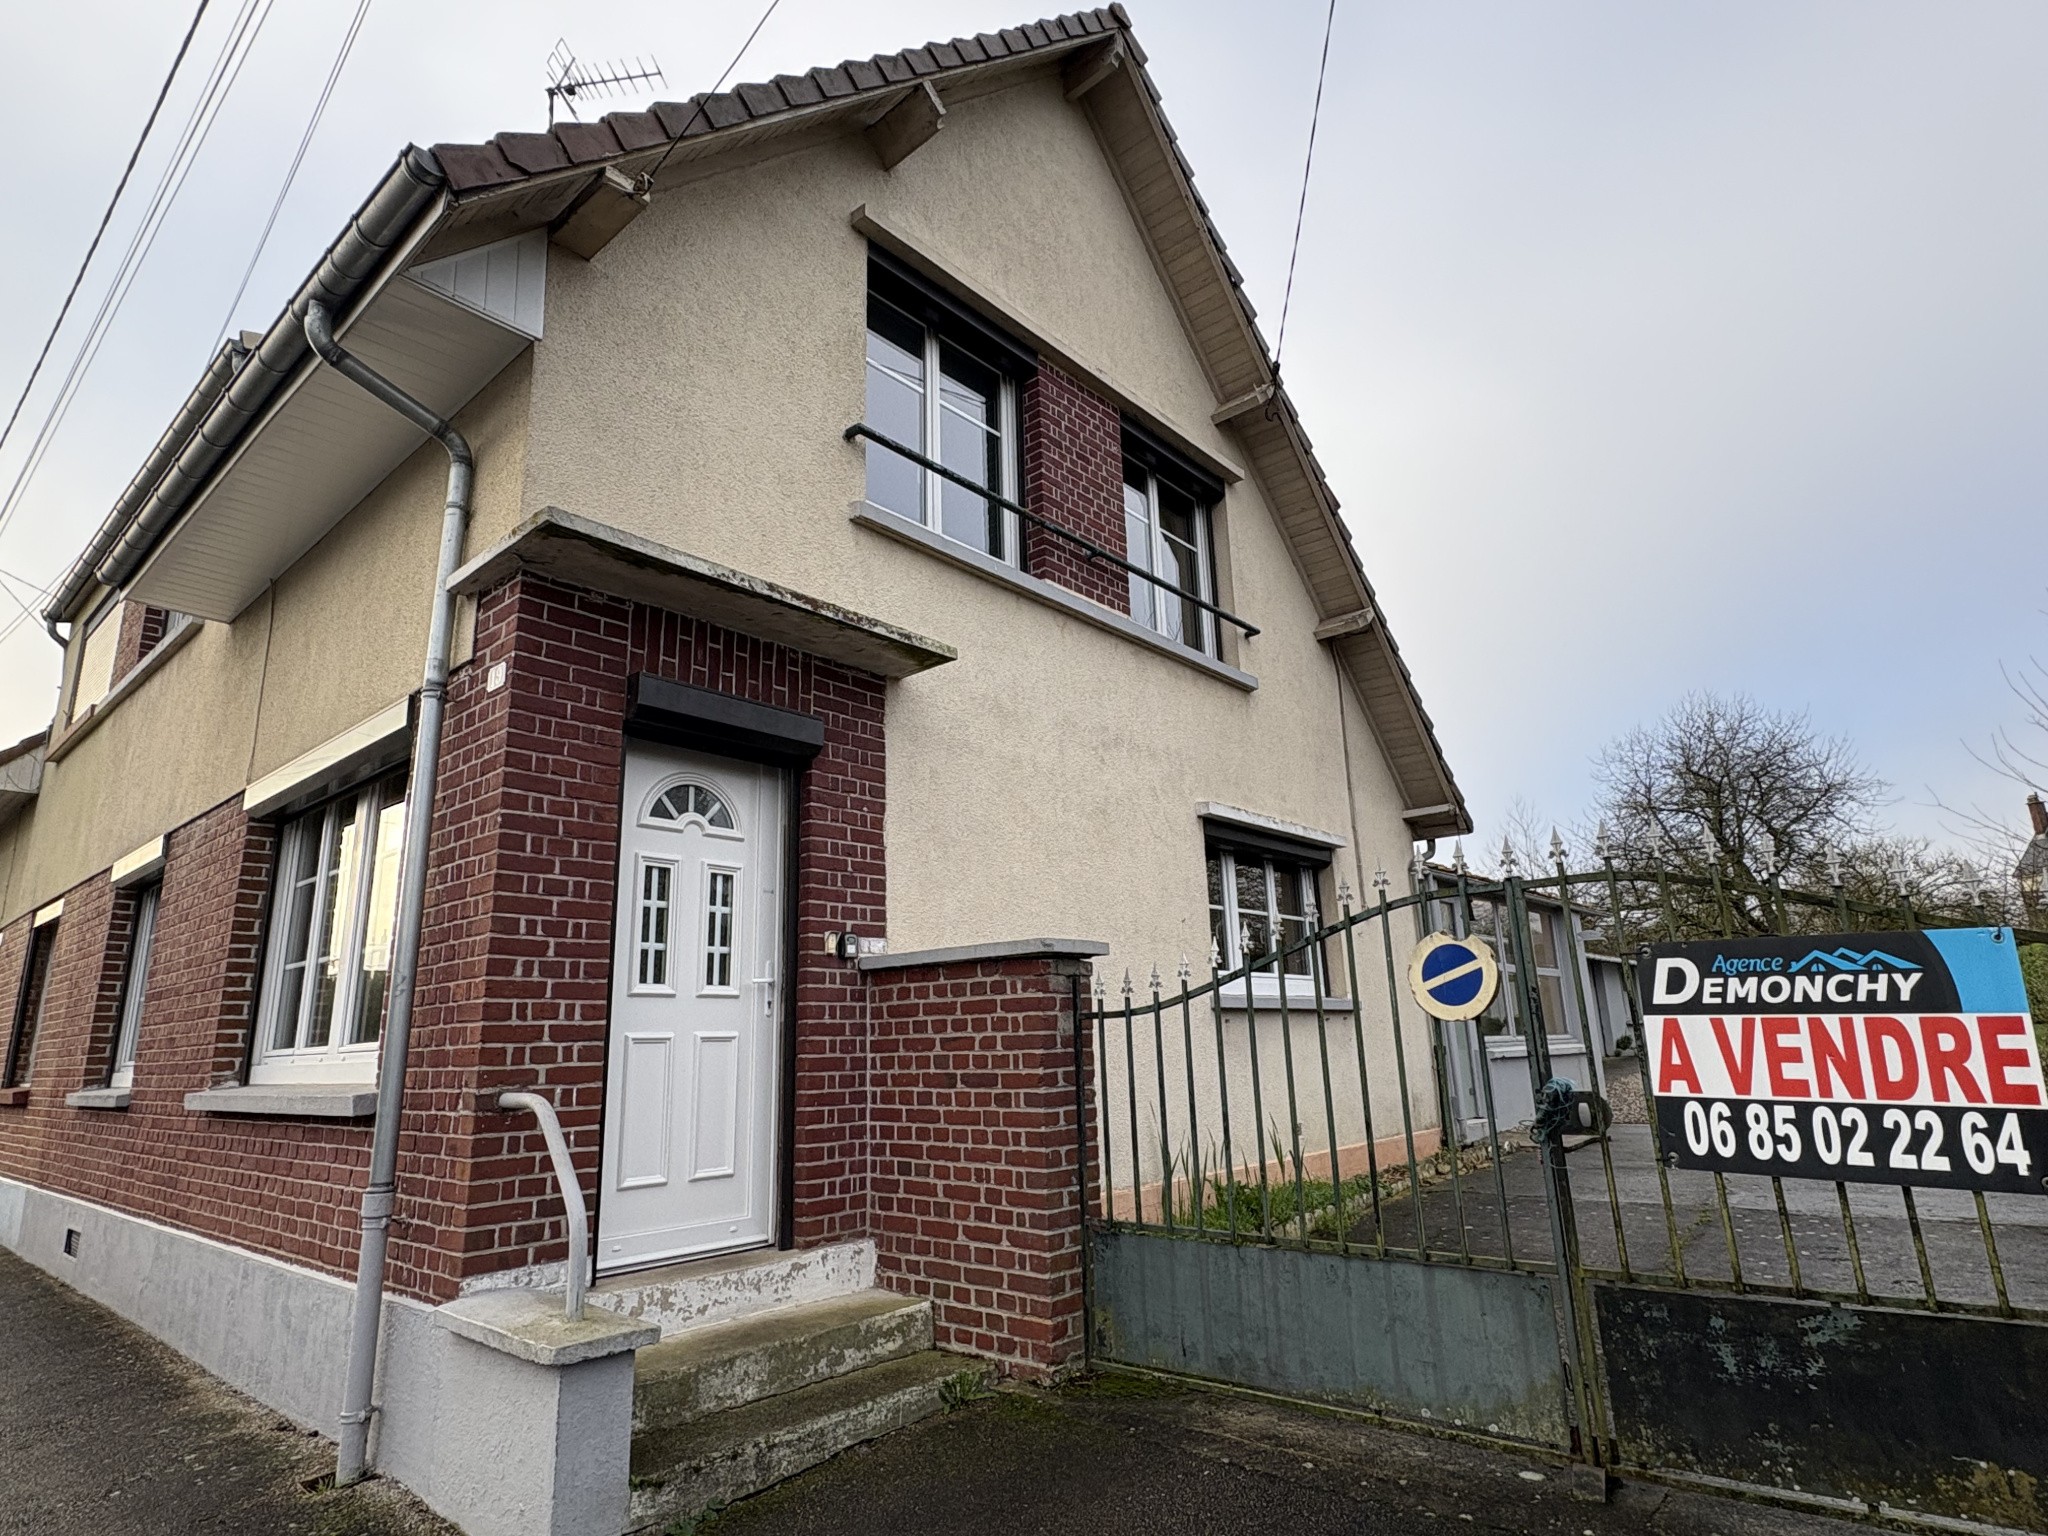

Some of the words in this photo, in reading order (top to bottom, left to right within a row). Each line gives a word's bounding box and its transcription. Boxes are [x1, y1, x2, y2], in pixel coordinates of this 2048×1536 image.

[1652, 957, 1923, 1005] DEMONCHY
[1711, 954, 1783, 976] Agence
[1658, 1018, 1703, 1094] A
[1709, 1016, 2041, 1105] VENDRE
[1684, 1101, 1736, 1158] 06
[1745, 1104, 1802, 1162] 85
[1812, 1106, 1875, 1167] 02
[1882, 1109, 1951, 1172] 22
[1960, 1111, 2032, 1176] 64
